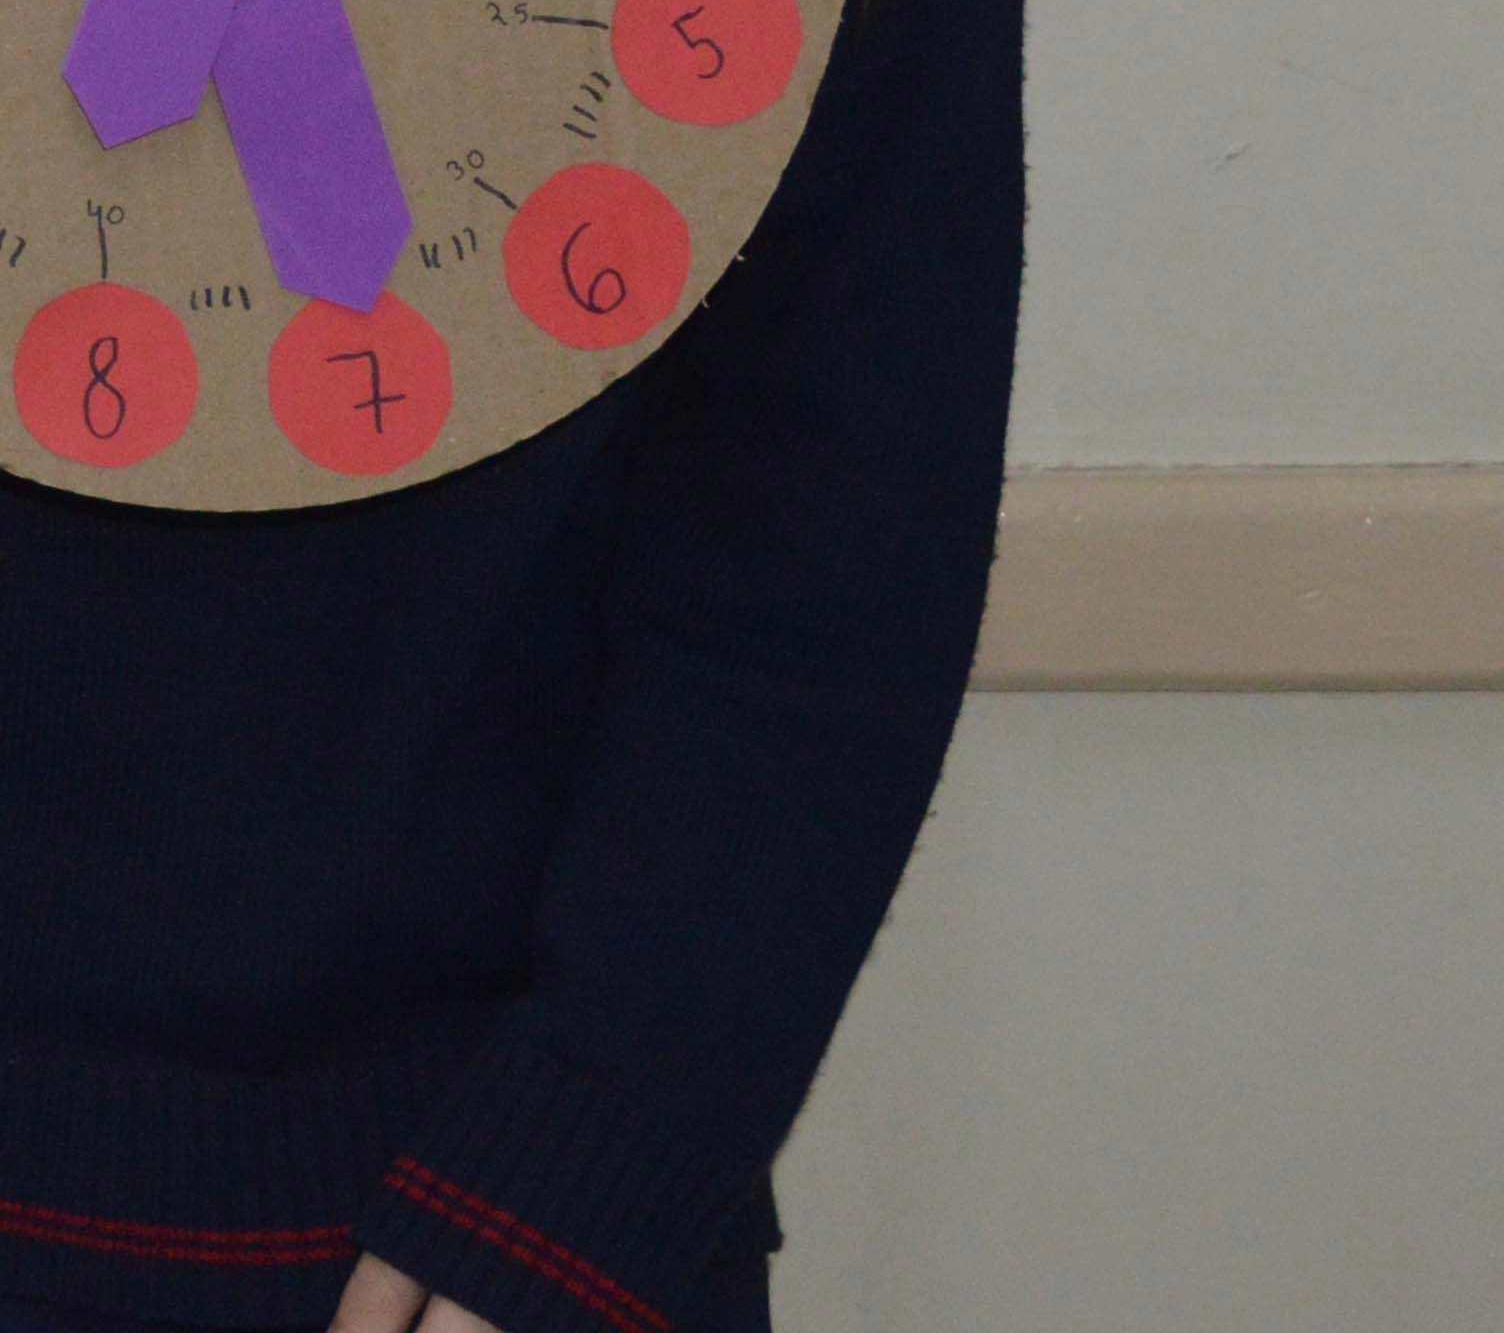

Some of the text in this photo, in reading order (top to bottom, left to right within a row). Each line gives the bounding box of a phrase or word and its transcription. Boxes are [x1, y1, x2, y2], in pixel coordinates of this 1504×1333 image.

[486, 1, 529, 27] 25
[671, 5, 725, 80] 5
[446, 148, 485, 181] 30
[86, 199, 125, 227] 40
[560, 223, 628, 315] 6
[83, 336, 127, 438] 8
[327, 350, 406, 434] 7
